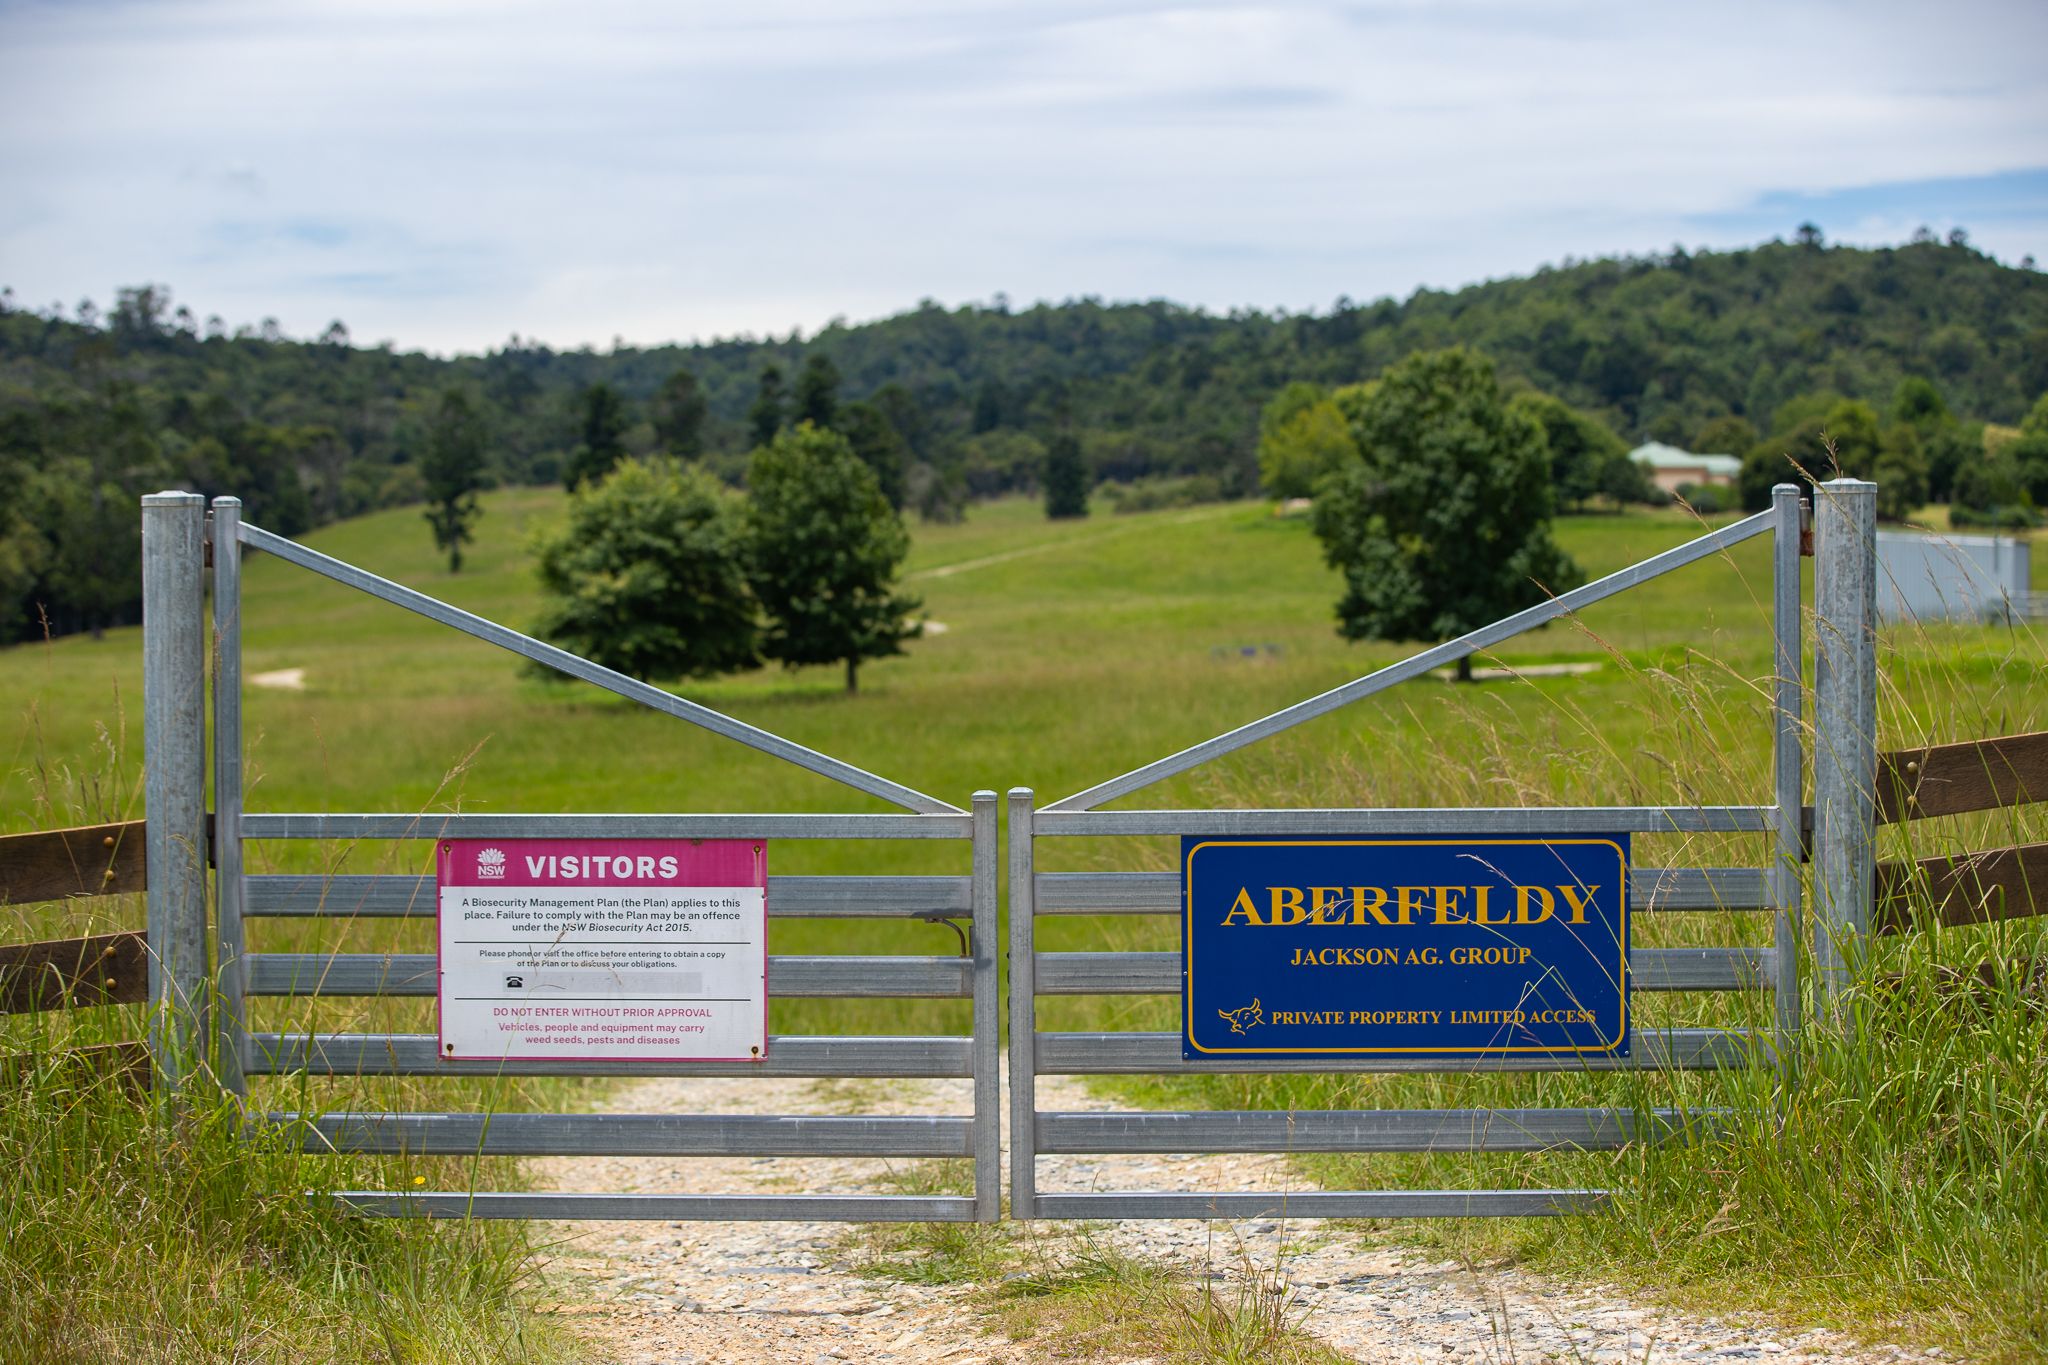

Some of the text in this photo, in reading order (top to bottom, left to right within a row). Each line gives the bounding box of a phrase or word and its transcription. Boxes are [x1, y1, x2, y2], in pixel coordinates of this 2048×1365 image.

[478, 866, 505, 875] NSW
[525, 856, 679, 878] VISITORS
[462, 898, 741, 909] A Biosecurity Management Plan (the Plan) applies to this
[1220, 885, 1601, 926] ABERFELDY
[464, 911, 494, 920] place.
[496, 911, 531, 919] Failure
[545, 911, 581, 921] comply
[584, 911, 605, 919] with
[608, 911, 624, 920] the
[626, 911, 648, 920] Plan
[650, 913, 671, 921] may
[674, 911, 686, 920] be
[702, 911, 740, 920] offence
[512, 923, 692, 933] under the NSW Biosecurity Act 2015.
[479, 949, 506, 957] Please
[507, 949, 532, 958] phone
[543, 949, 560, 957] visit
[576, 949, 599, 957] office
[600, 950, 627, 958] before
[628, 950, 662, 959] entering
[673, 950, 699, 958] obtain
[1290, 947, 1532, 966] JACKSON AG. GROUP
[631, 960, 677, 969] obligations.
[493, 1008, 712, 1017] DO NOT ENTER WITHOUT PRIOR APPROVAL
[1271, 1009, 1597, 1026] PRIVATE PROPERTY LIMITED ACCESS
[498, 1023, 705, 1034] Vehicles, people and equipment may carry
[525, 1036, 680, 1045] weed seeds, pests and diseases
